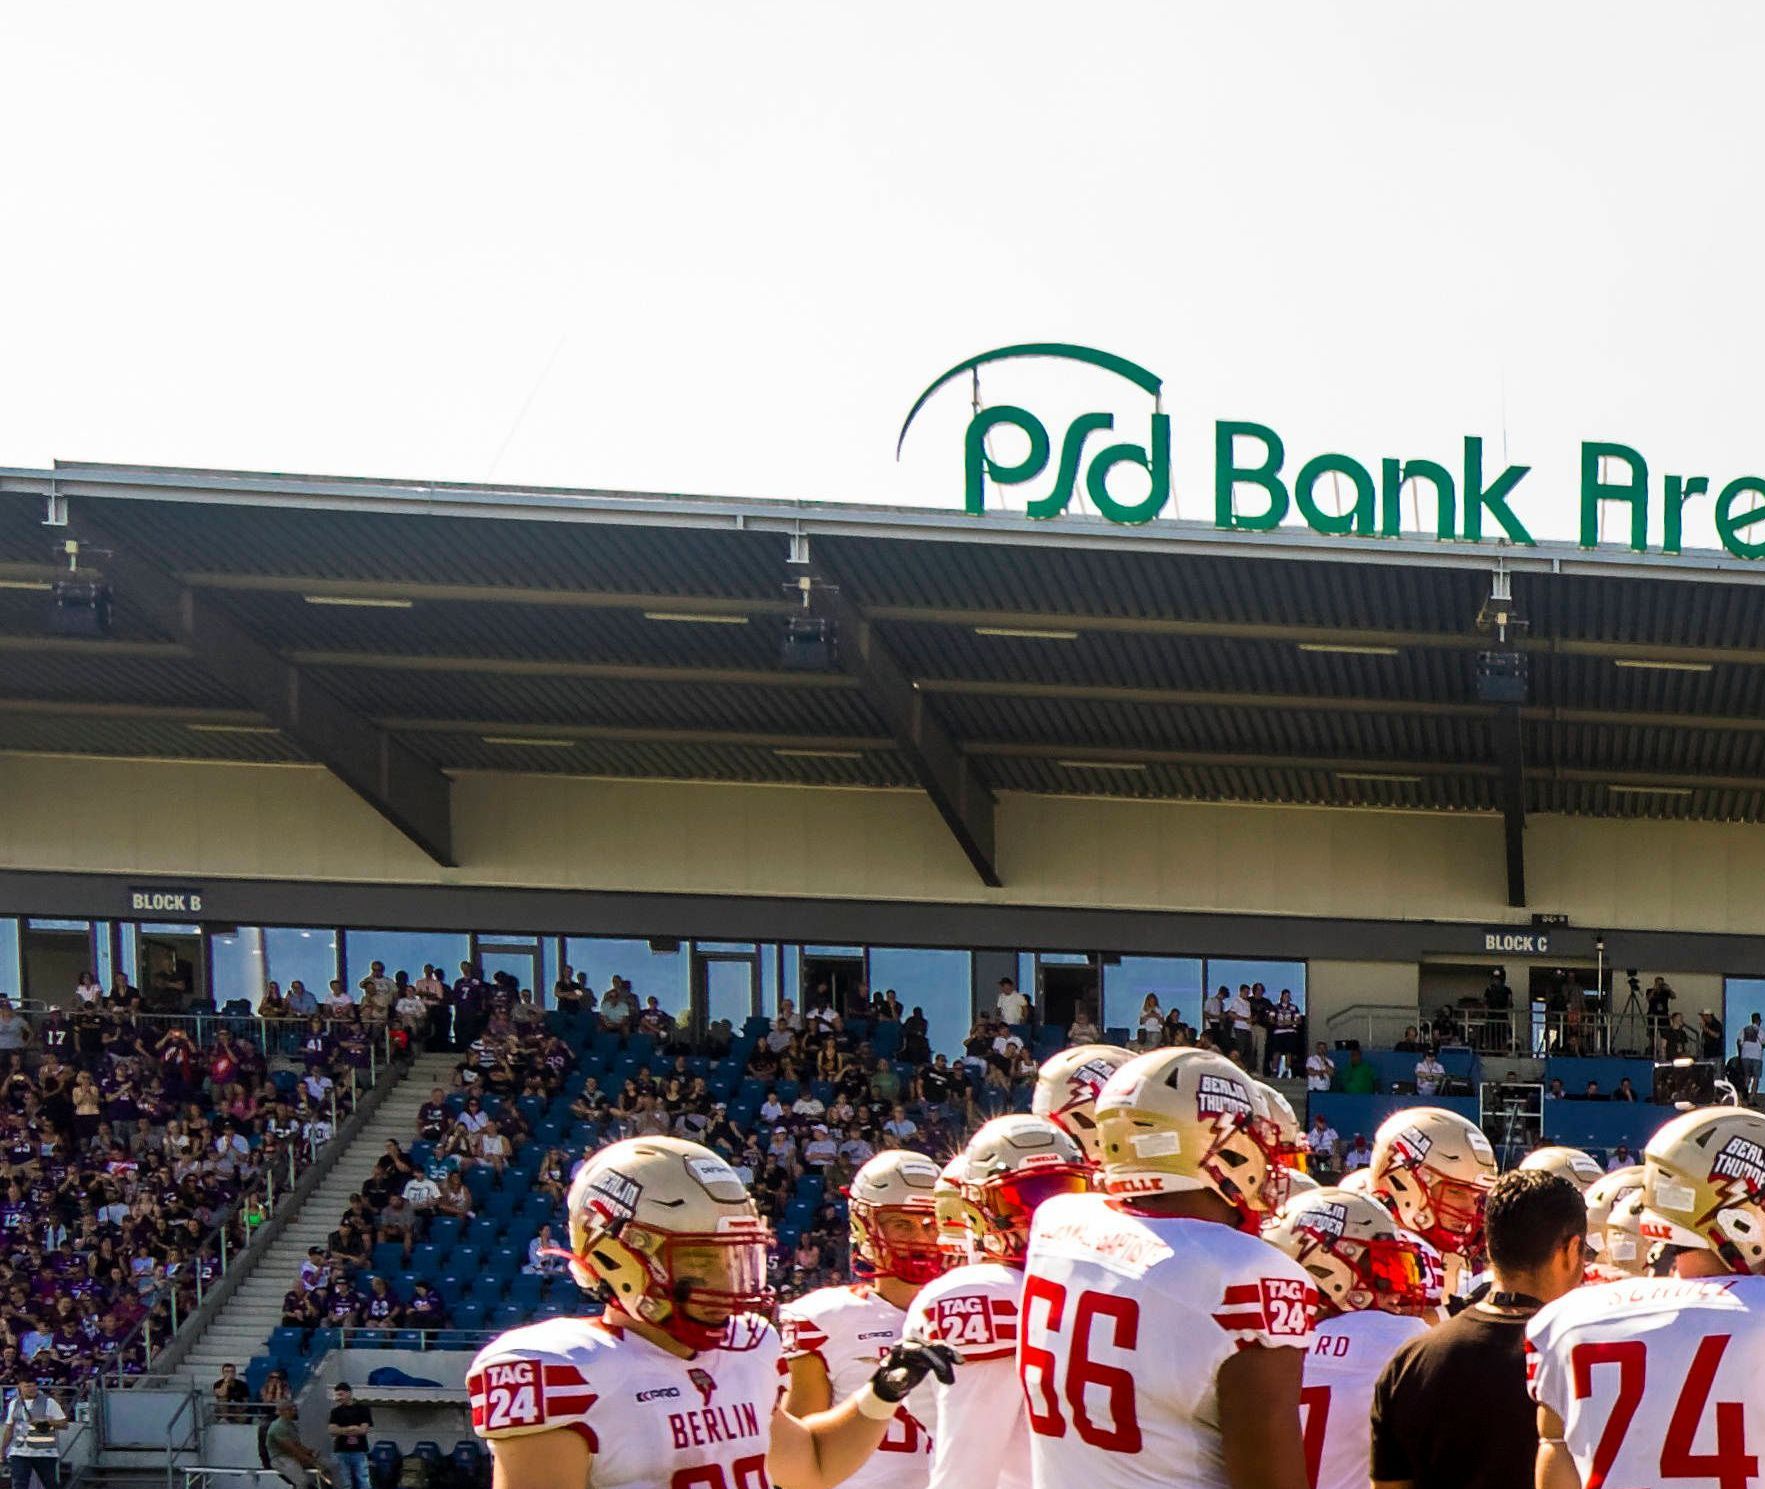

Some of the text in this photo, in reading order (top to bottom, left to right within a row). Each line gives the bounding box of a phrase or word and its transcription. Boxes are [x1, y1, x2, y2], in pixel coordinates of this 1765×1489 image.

[964, 406, 1170, 525] psd
[1216, 419, 1535, 547] Bank
[133, 893, 202, 911] BLOCK B
[1485, 934, 1548, 952] BLOCK C
[48, 1030, 67, 1045] 17
[307, 1039, 323, 1051] 41
[1265, 1280, 1304, 1299] TAG
[941, 1297, 983, 1315] TAG
[1269, 1300, 1307, 1335] 24
[941, 1314, 991, 1346] 24
[1314, 1336, 1350, 1357] RD
[486, 1362, 535, 1387] TAG
[1020, 1274, 1143, 1454] 66
[487, 1386, 539, 1429] 24
[667, 1402, 760, 1450] BERLIN
